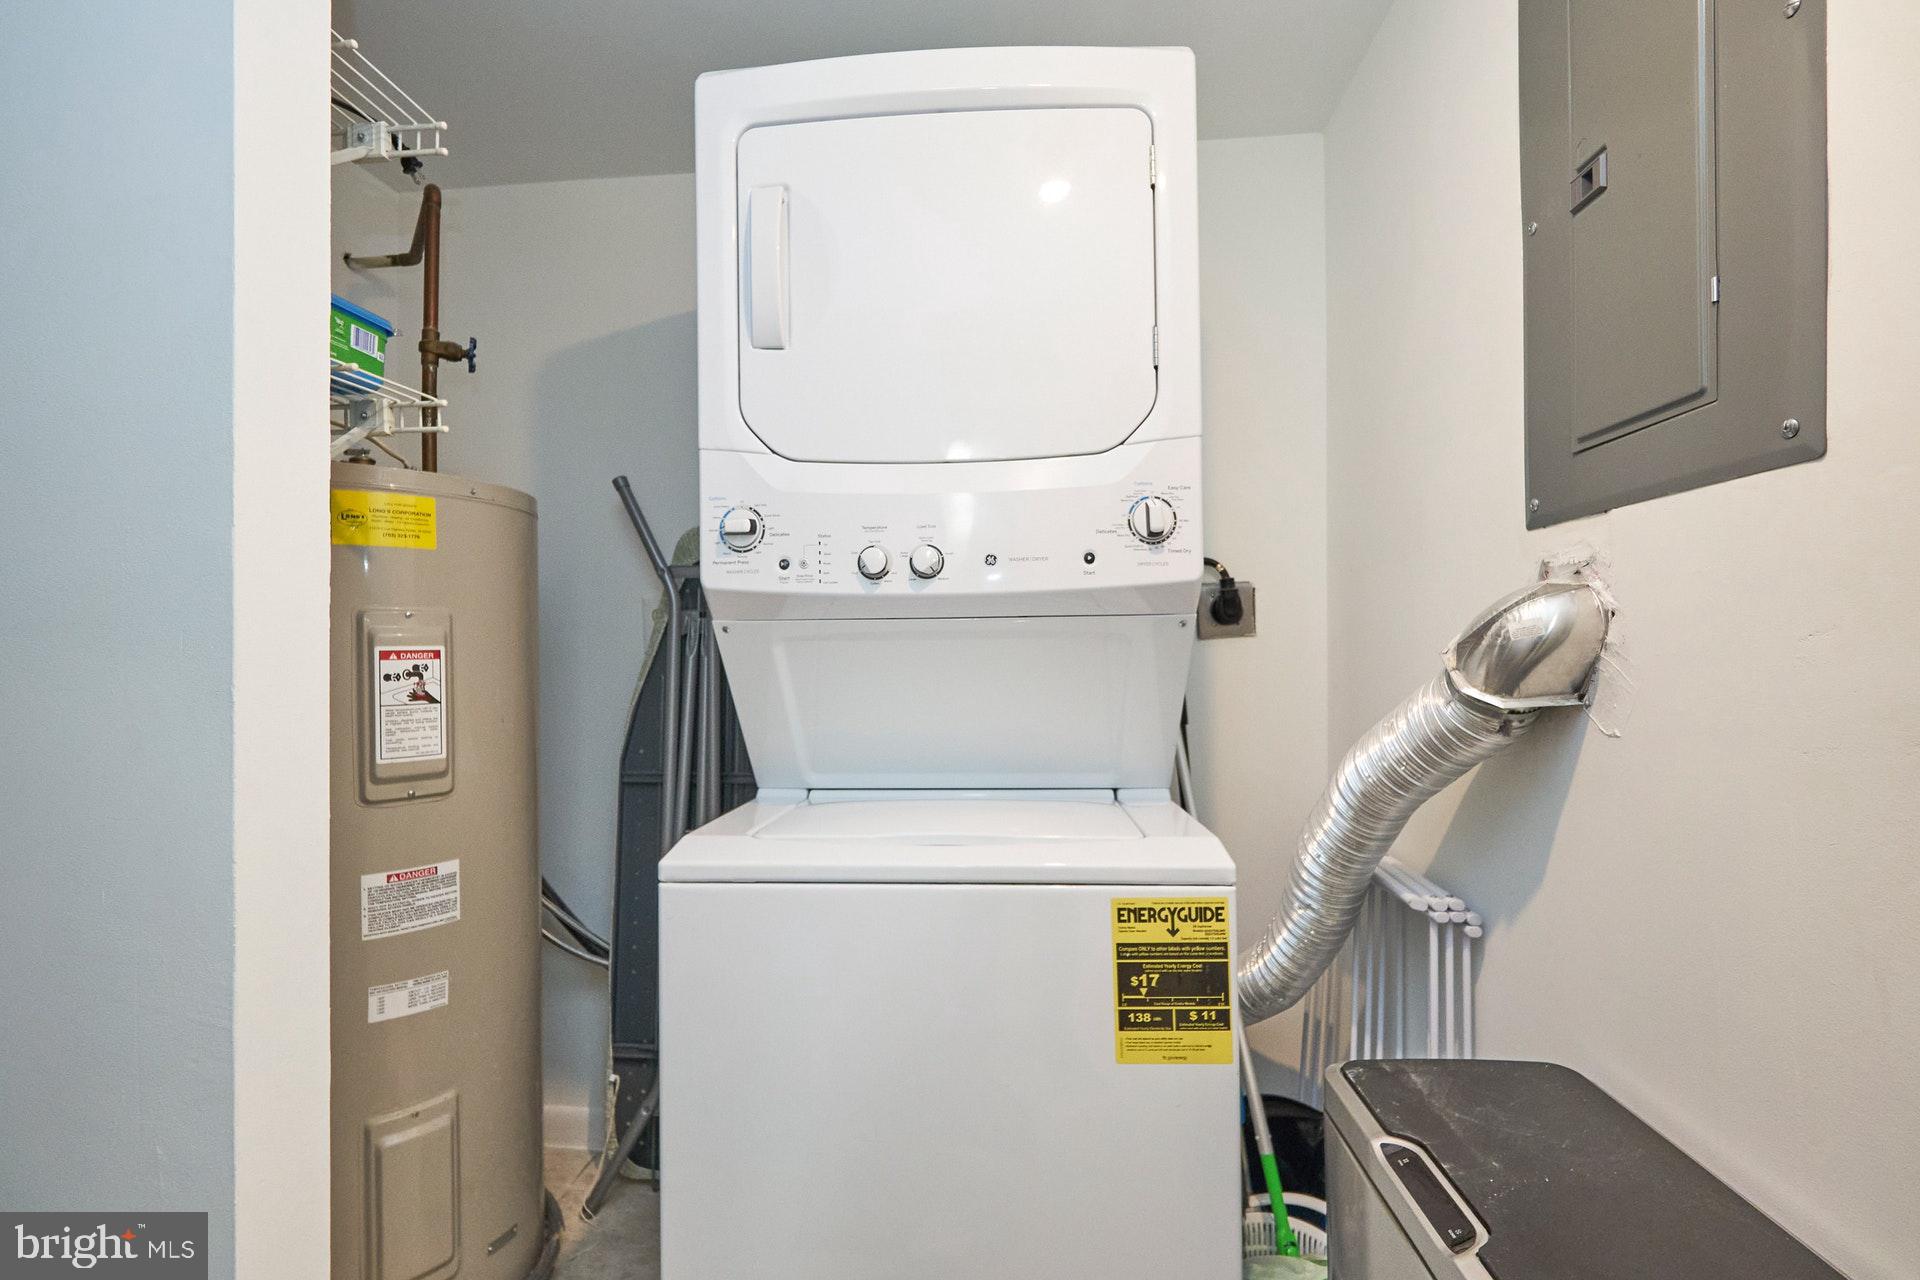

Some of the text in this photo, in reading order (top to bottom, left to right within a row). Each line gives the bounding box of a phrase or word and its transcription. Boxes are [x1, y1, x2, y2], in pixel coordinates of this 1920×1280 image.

[392, 509, 432, 517] CORPORATION
[400, 866, 436, 880] DANGER
[1117, 906, 1225, 924] ENERGYGUIDE
[1130, 974, 1160, 987] $17
[1128, 1013, 1151, 1022] 138
[1189, 1010, 1216, 1021] $ 11
